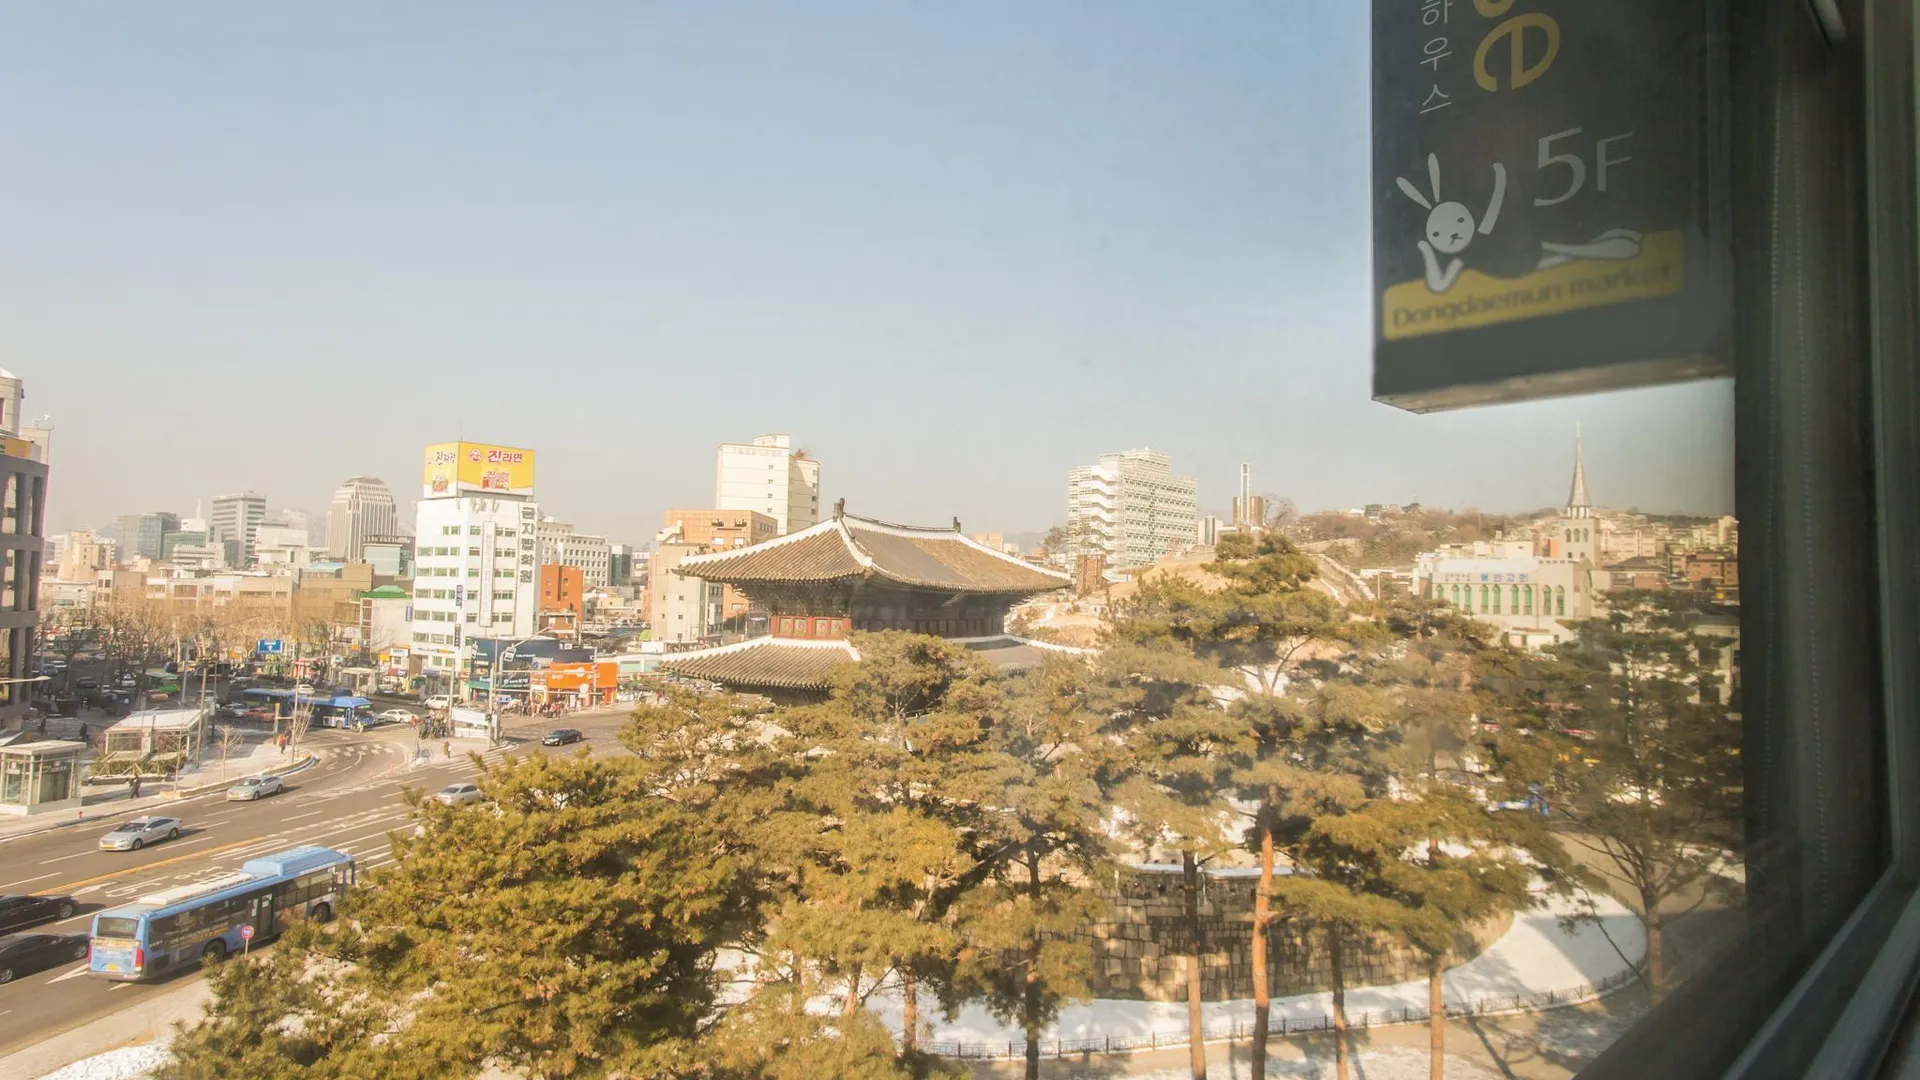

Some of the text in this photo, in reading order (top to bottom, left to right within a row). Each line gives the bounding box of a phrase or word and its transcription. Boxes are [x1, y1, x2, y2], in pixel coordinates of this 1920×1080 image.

[1419, 0, 1453, 115] 하우스
[1533, 127, 1635, 207] 5F
[1392, 262, 1675, 329] Dongdaemun market
[487, 450, 524, 463] 진라면
